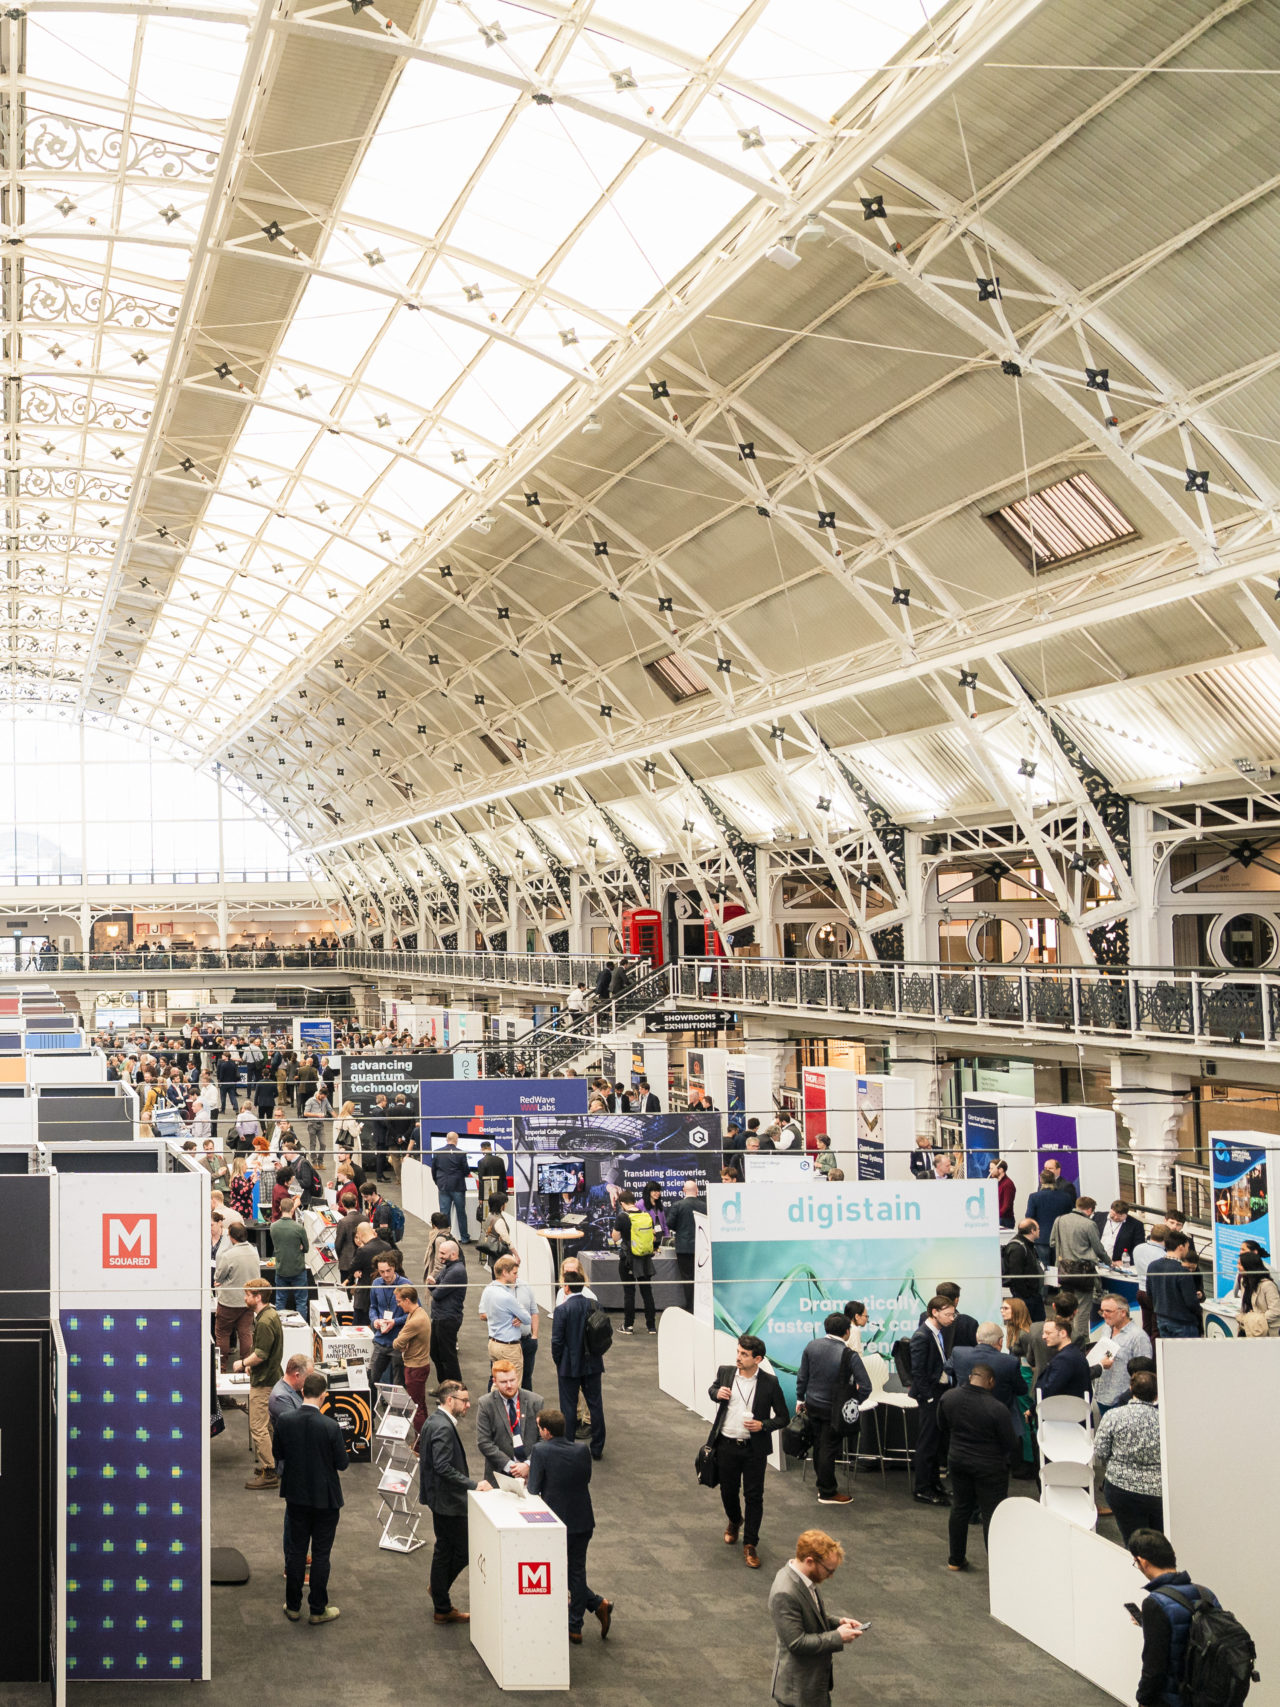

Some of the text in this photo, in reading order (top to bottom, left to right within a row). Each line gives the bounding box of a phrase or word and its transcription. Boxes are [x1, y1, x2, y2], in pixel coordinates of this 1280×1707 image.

[664, 1013, 716, 1022] SHOWROOMS
[664, 1022, 717, 1030] EXHIBITIONS
[350, 1060, 413, 1071] advancing
[350, 1072, 405, 1082] quantum
[350, 1083, 419, 1094] technology
[519, 1096, 556, 1104] RedWave
[623, 1169, 707, 1178] Translating discoveries
[787, 1194, 921, 1229] digistain
[109, 1219, 151, 1256] M
[109, 1257, 151, 1266] SQUARED
[799, 1295, 920, 1315] Dramtically
[767, 1318, 821, 1334] faster
[522, 1564, 547, 1588] M
